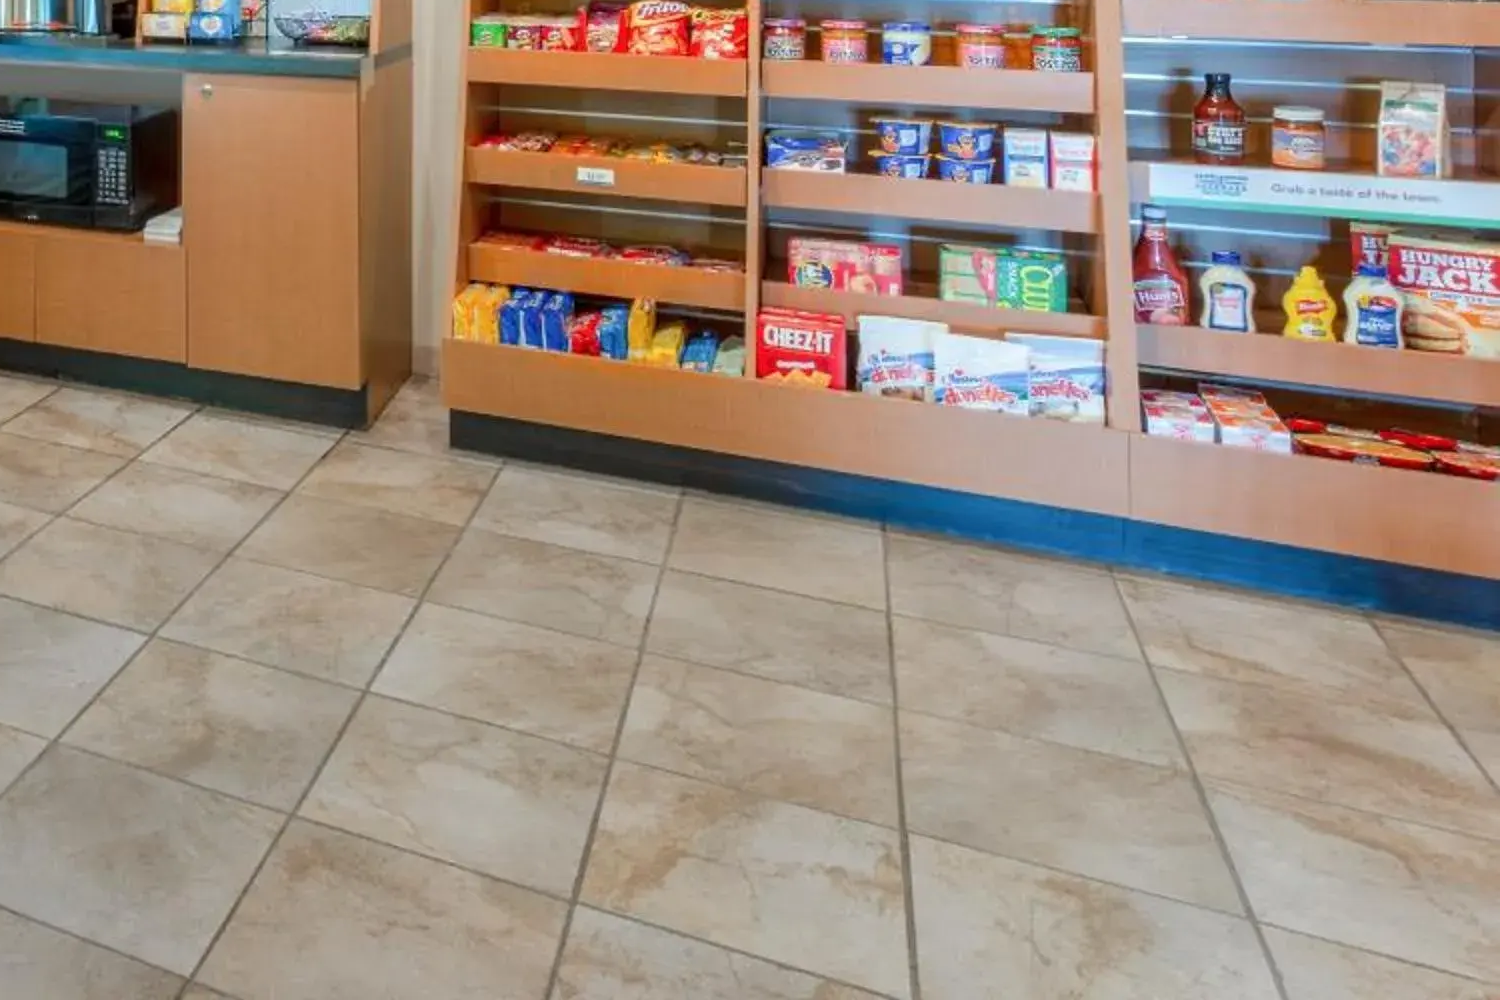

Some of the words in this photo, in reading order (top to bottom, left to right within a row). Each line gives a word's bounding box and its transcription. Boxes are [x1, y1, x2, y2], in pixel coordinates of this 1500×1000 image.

[1270, 182, 1305, 196] Grab
[1320, 186, 1352, 199] taste
[1357, 189, 1372, 200] of
[1376, 191, 1399, 202] the
[1400, 250, 1493, 272] HUNGRY
[1399, 265, 1499, 292] JACK
[763, 325, 835, 355] CHEEZ-IT
[944, 386, 1020, 408] donettes
